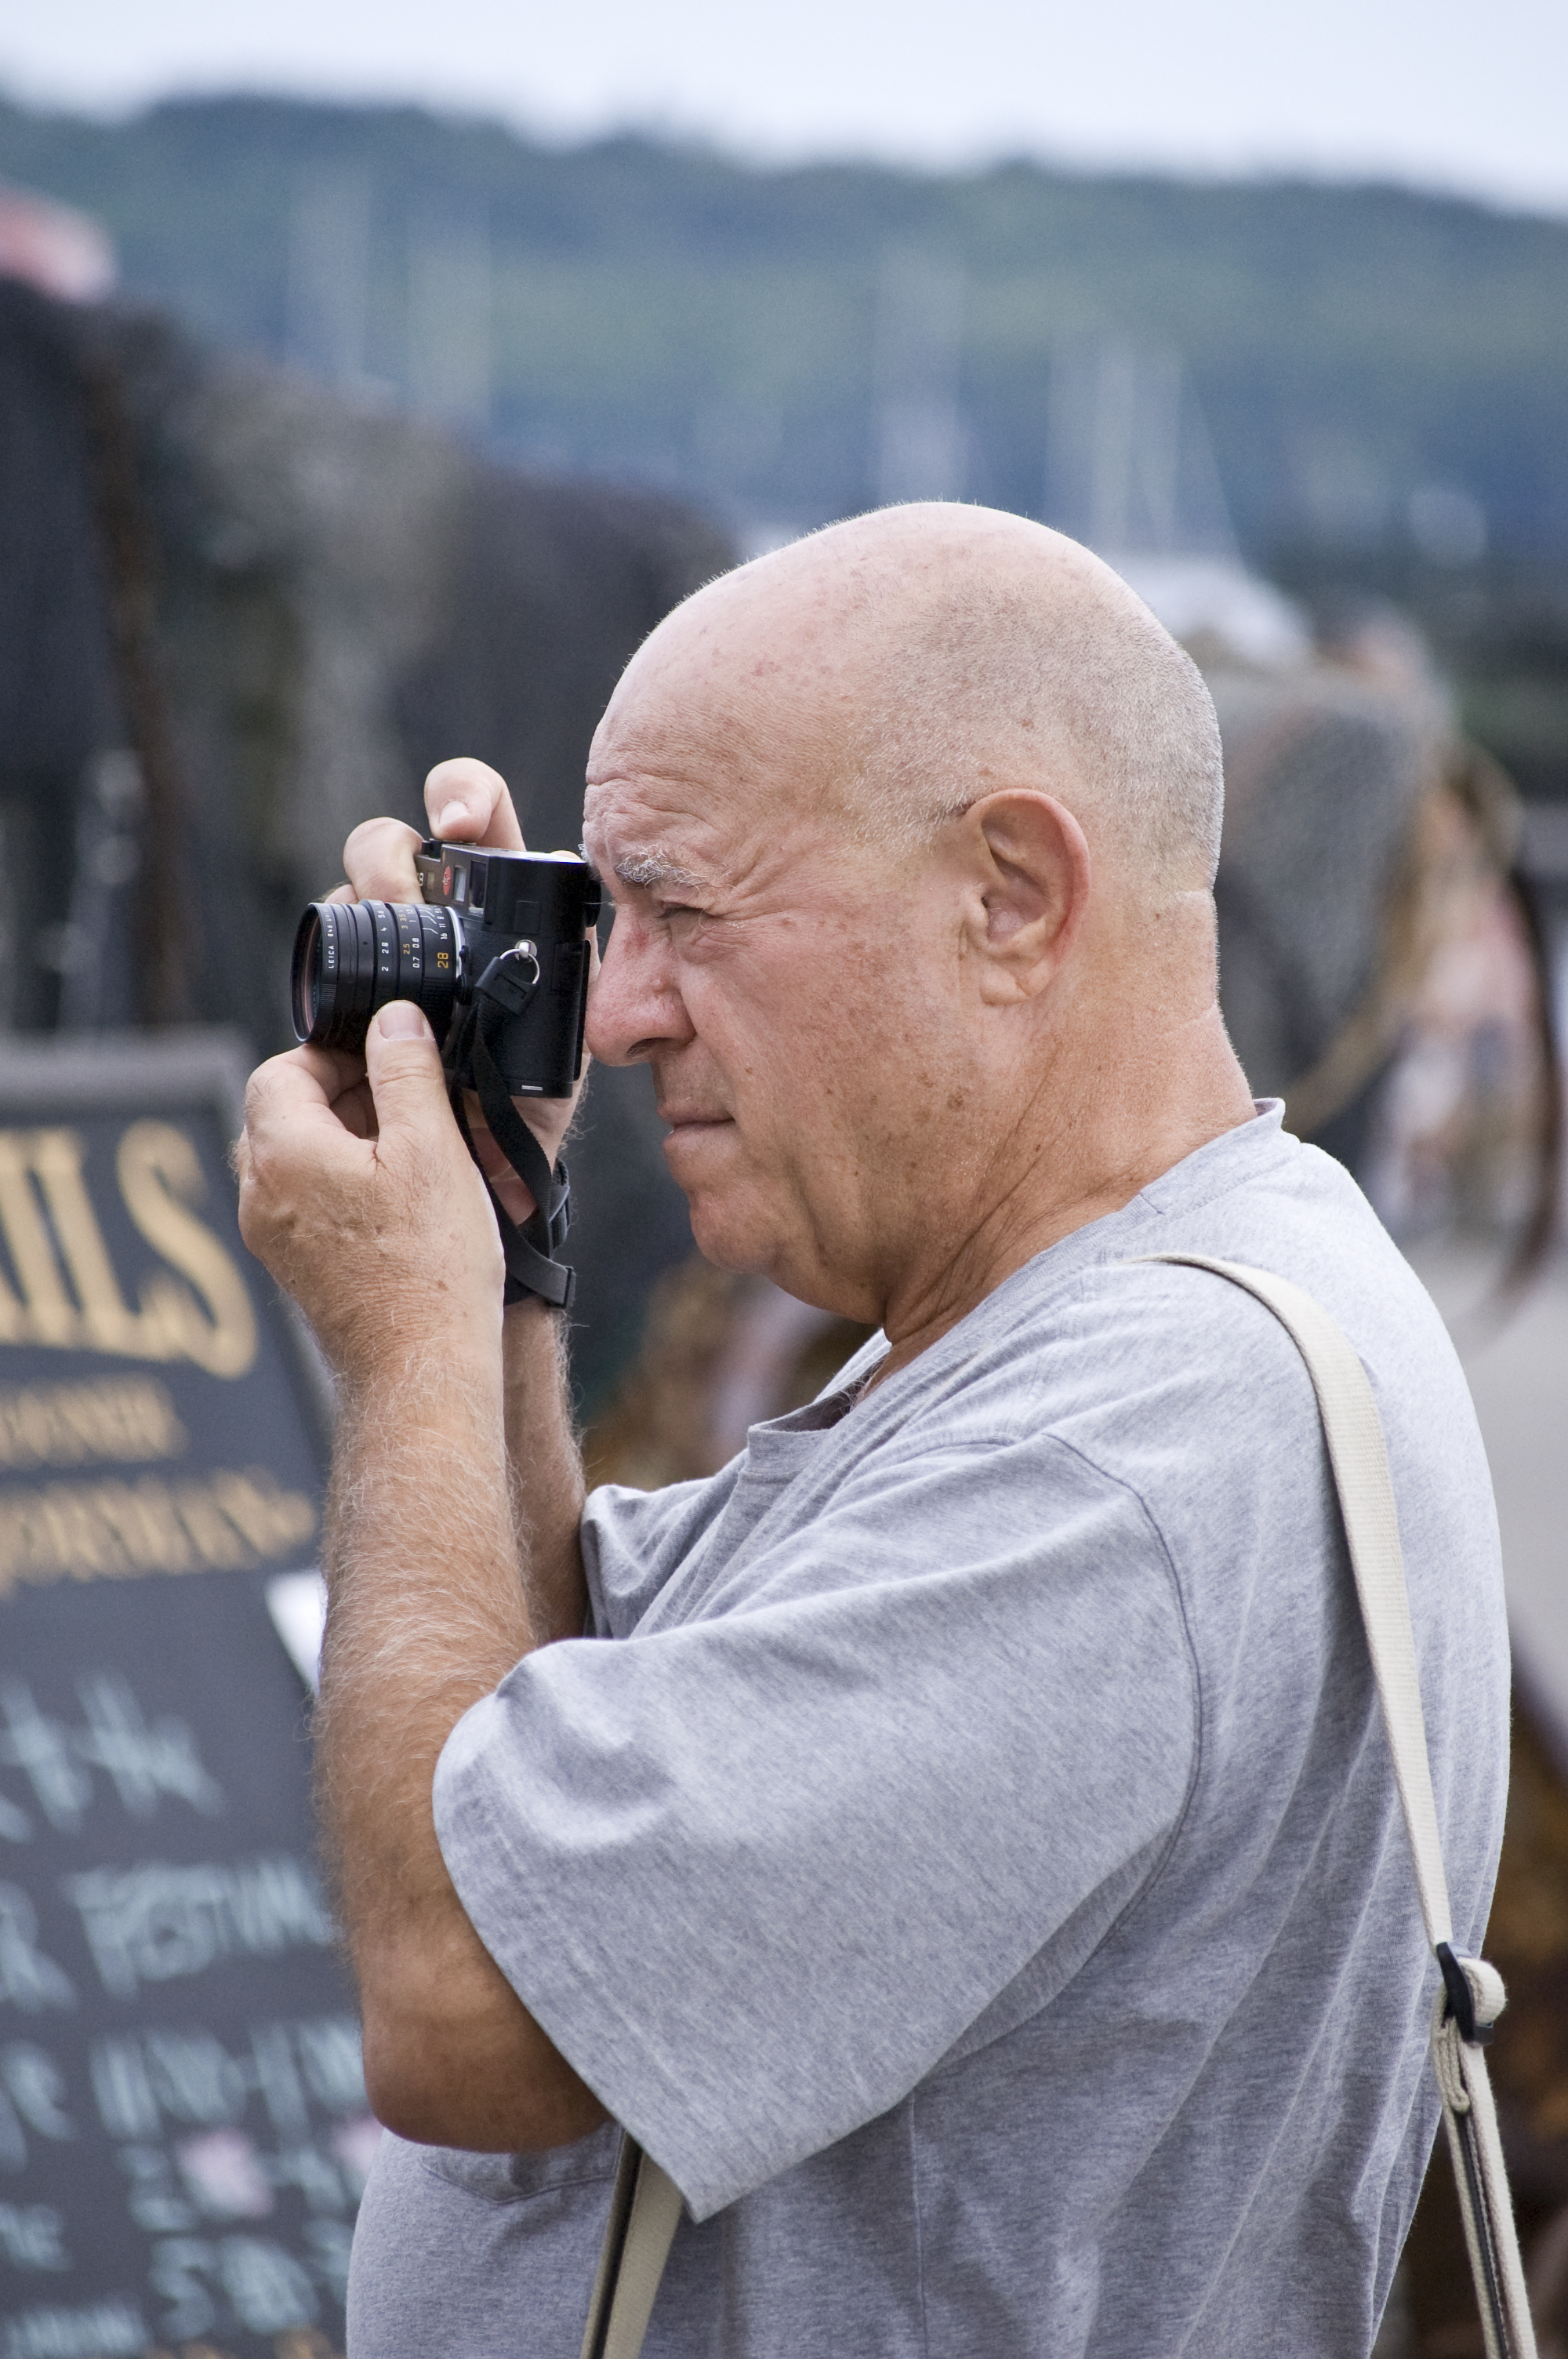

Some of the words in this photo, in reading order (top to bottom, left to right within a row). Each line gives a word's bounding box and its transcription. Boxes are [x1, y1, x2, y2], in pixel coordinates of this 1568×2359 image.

[419, 872, 424, 887] 8
[381, 941, 390, 954] 2.8
[412, 937, 420, 949] 0.8
[437, 952, 448, 969] 28
[0, 1123, 259, 1379] ILS
